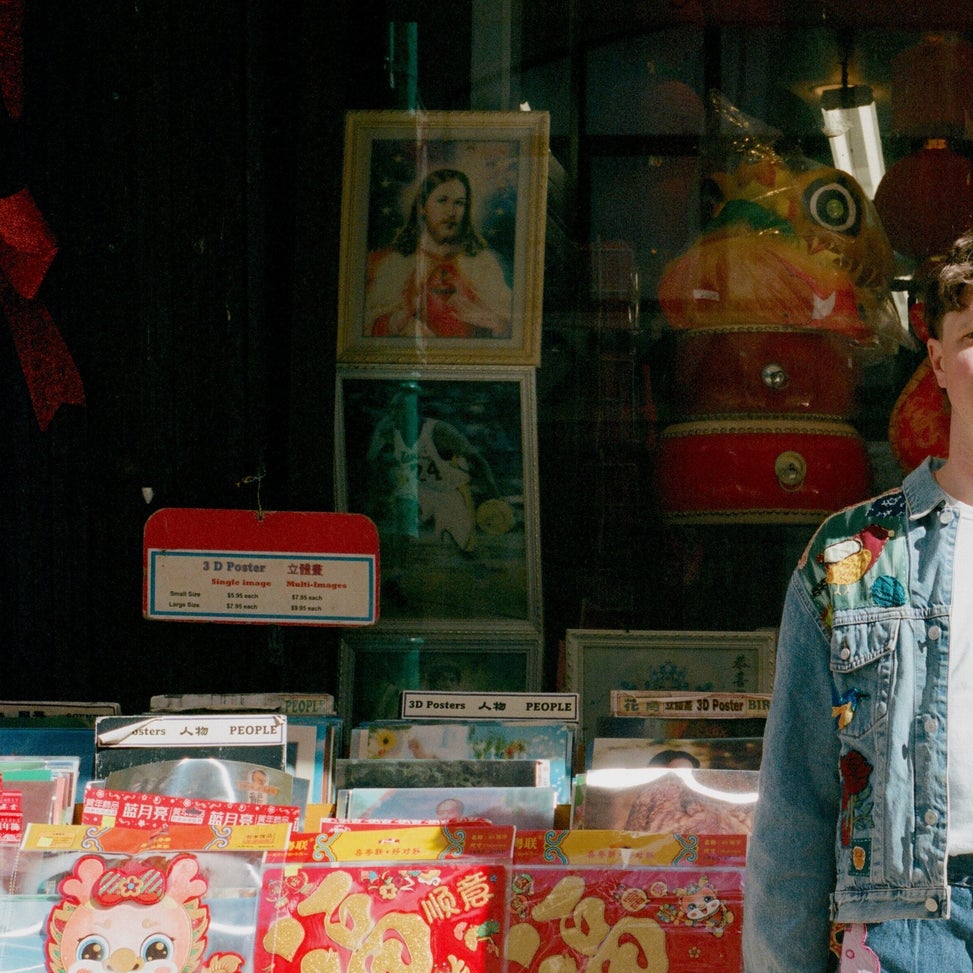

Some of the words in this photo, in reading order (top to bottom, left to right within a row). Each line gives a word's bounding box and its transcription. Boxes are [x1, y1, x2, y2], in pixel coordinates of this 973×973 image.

[202, 560, 210, 571] 3
[213, 561, 223, 572] D
[226, 561, 266, 573] Poster
[211, 577, 240, 587] Single
[286, 580, 347, 590] Multi-Images
[169, 590, 187, 598] Small
[168, 602, 186, 610] Large
[408, 700, 424, 709] 3D
[426, 700, 466, 710] Posters
[478, 701, 507, 711] 人物
[525, 702, 572, 712] PEOPLE
[696, 699, 710, 711] 3D
[712, 699, 744, 712] Poster
[748, 699, 770, 711] BIR
[131, 725, 166, 737] osters
[180, 725, 209, 737] 人物
[229, 725, 278, 736] PEOPLE
[122, 802, 169, 822] 蓝月亮
